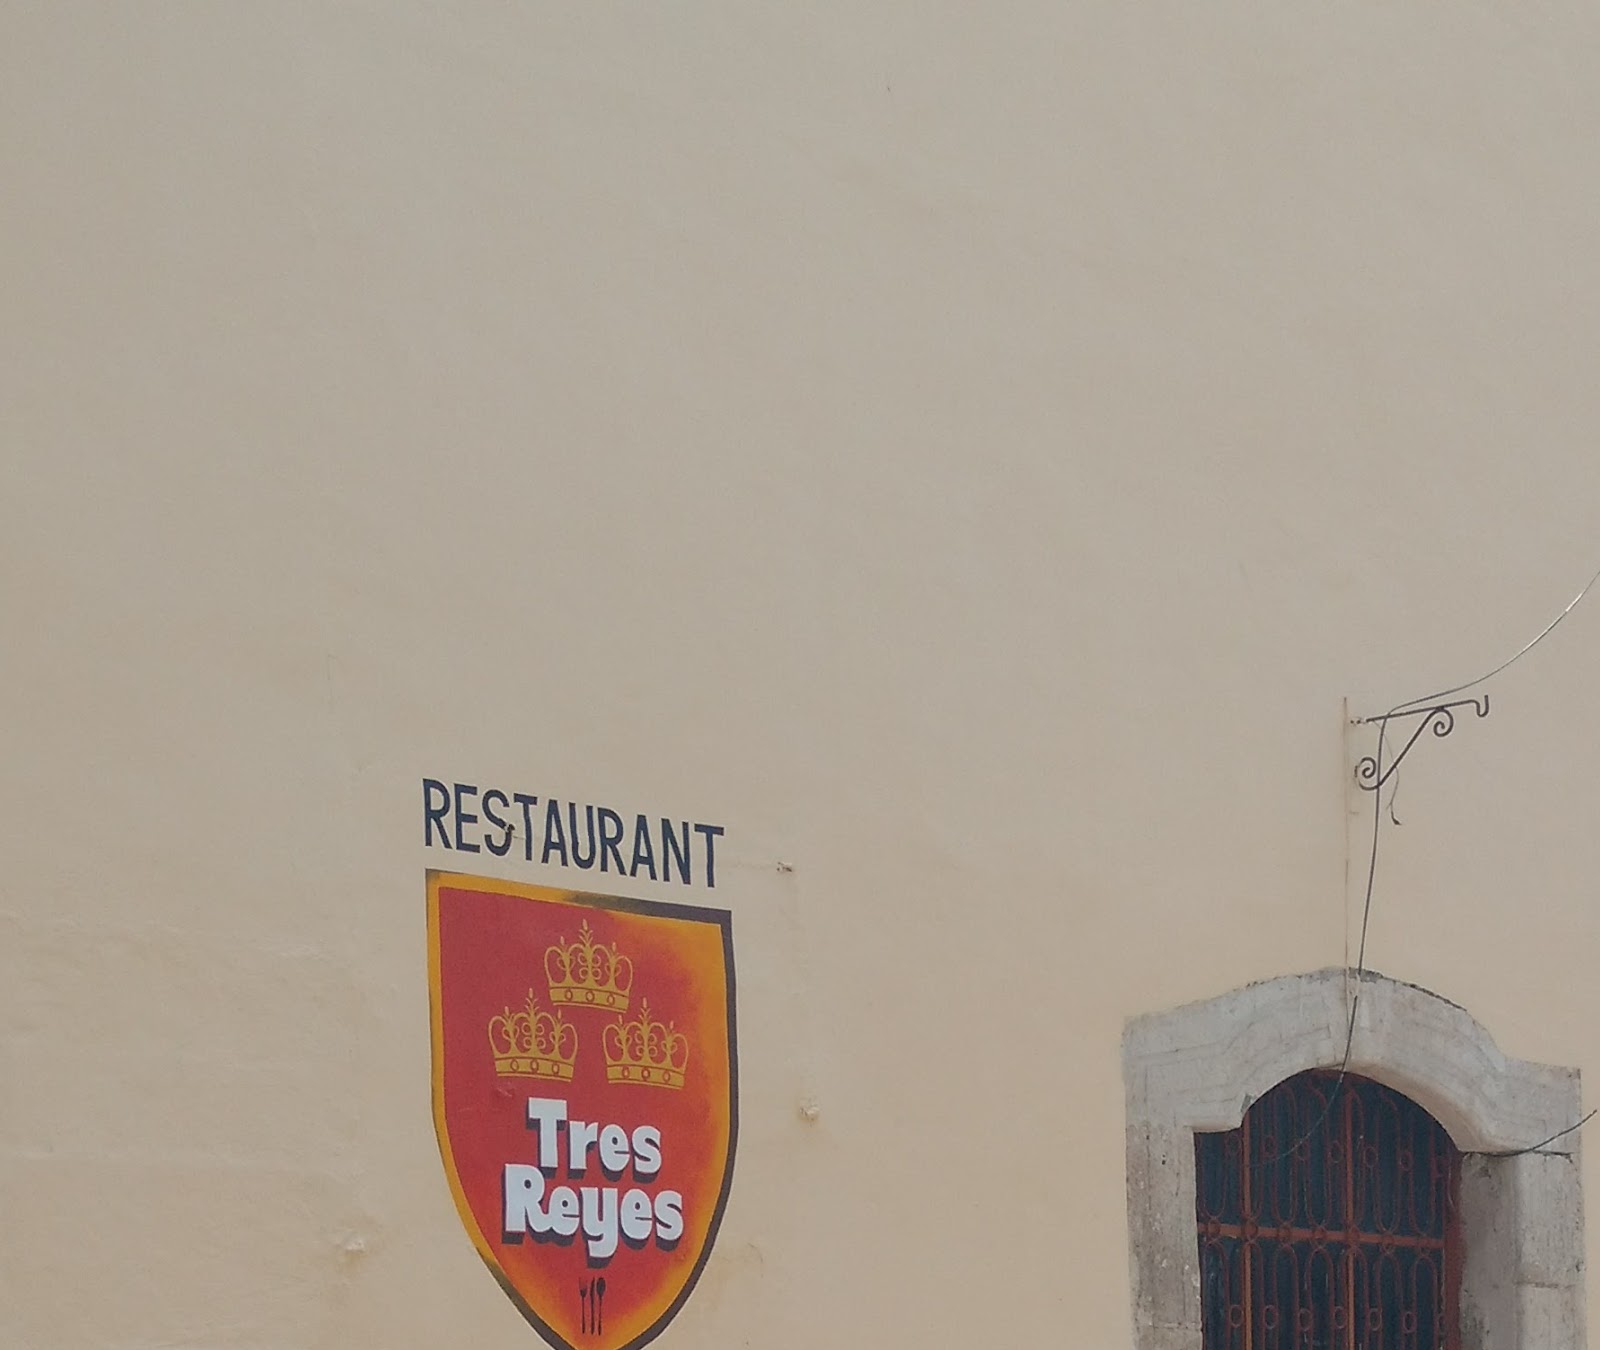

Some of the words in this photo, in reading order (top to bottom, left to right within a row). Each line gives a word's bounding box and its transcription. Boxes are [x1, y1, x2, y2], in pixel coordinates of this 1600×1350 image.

[422, 777, 725, 888] RESTAURANT
[526, 1097, 663, 1180] Tres
[503, 1162, 685, 1262] Reyes
